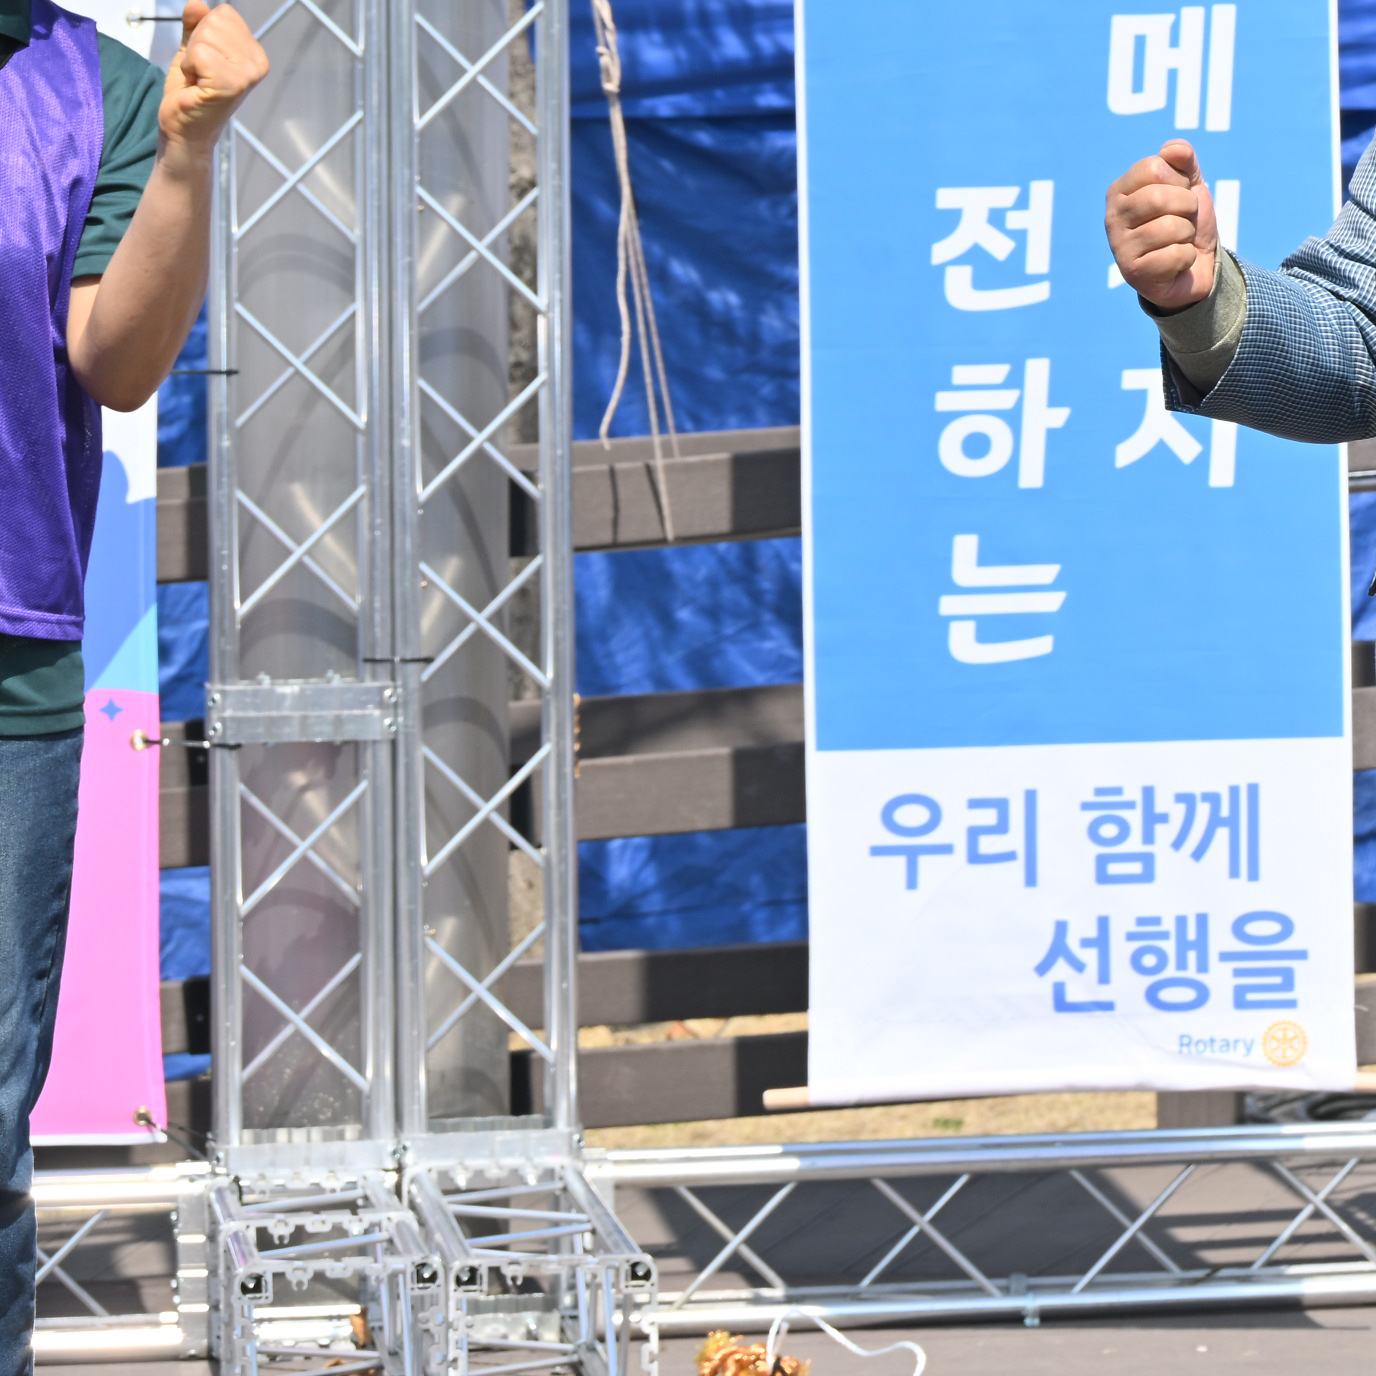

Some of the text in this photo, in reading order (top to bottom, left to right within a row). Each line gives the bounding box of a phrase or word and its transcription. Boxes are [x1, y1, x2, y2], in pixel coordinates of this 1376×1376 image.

[1106, 3, 1240, 488] 메지
[931, 179, 1071, 664] 전하는
[869, 782, 1261, 891] 우리 함께
[1033, 910, 1310, 1014] 선행을
[1178, 1033, 1255, 1056] Rotary
